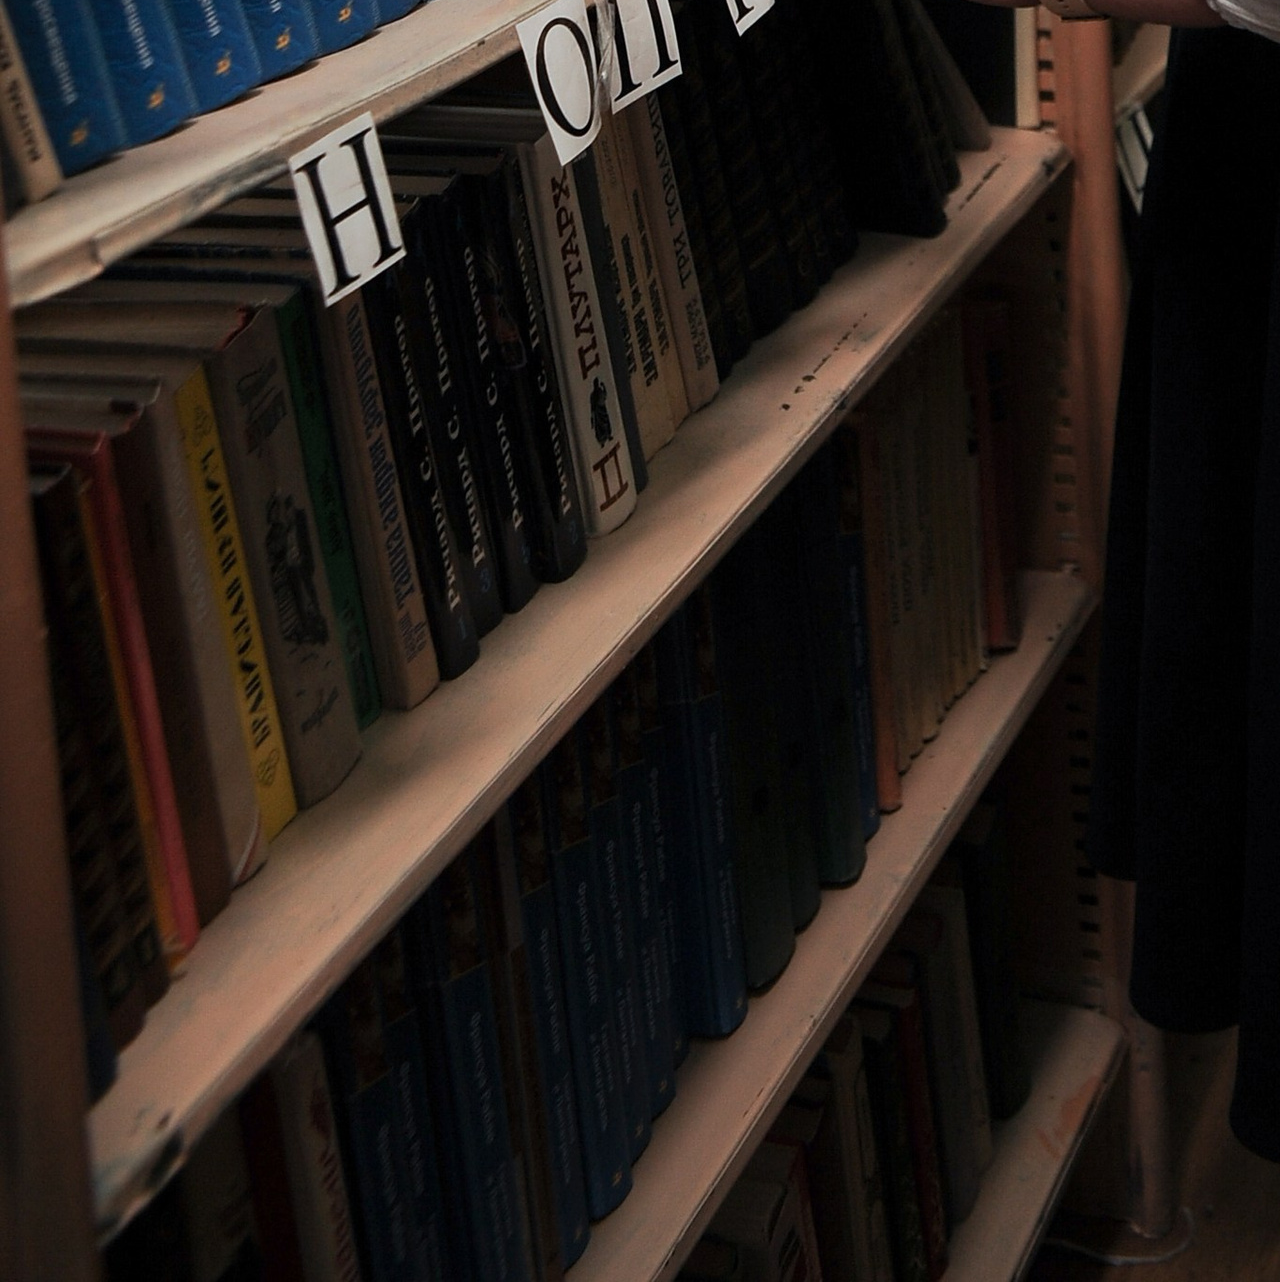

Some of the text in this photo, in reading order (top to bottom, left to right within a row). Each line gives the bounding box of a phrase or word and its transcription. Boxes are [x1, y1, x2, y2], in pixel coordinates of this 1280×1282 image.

[536, 17, 595, 137] О
[294, 127, 403, 297] Н
[550, 171, 600, 379] ПЛУТАРХ
[667, 230, 697, 288] ТРИ
[389, 312, 463, 611] Ричард С. Пратер
[418, 274, 489, 567] Ричард С. Пратер
[459, 244, 526, 530] Ричард С. Пратер
[511, 235, 573, 516] Ричард С. Пратер
